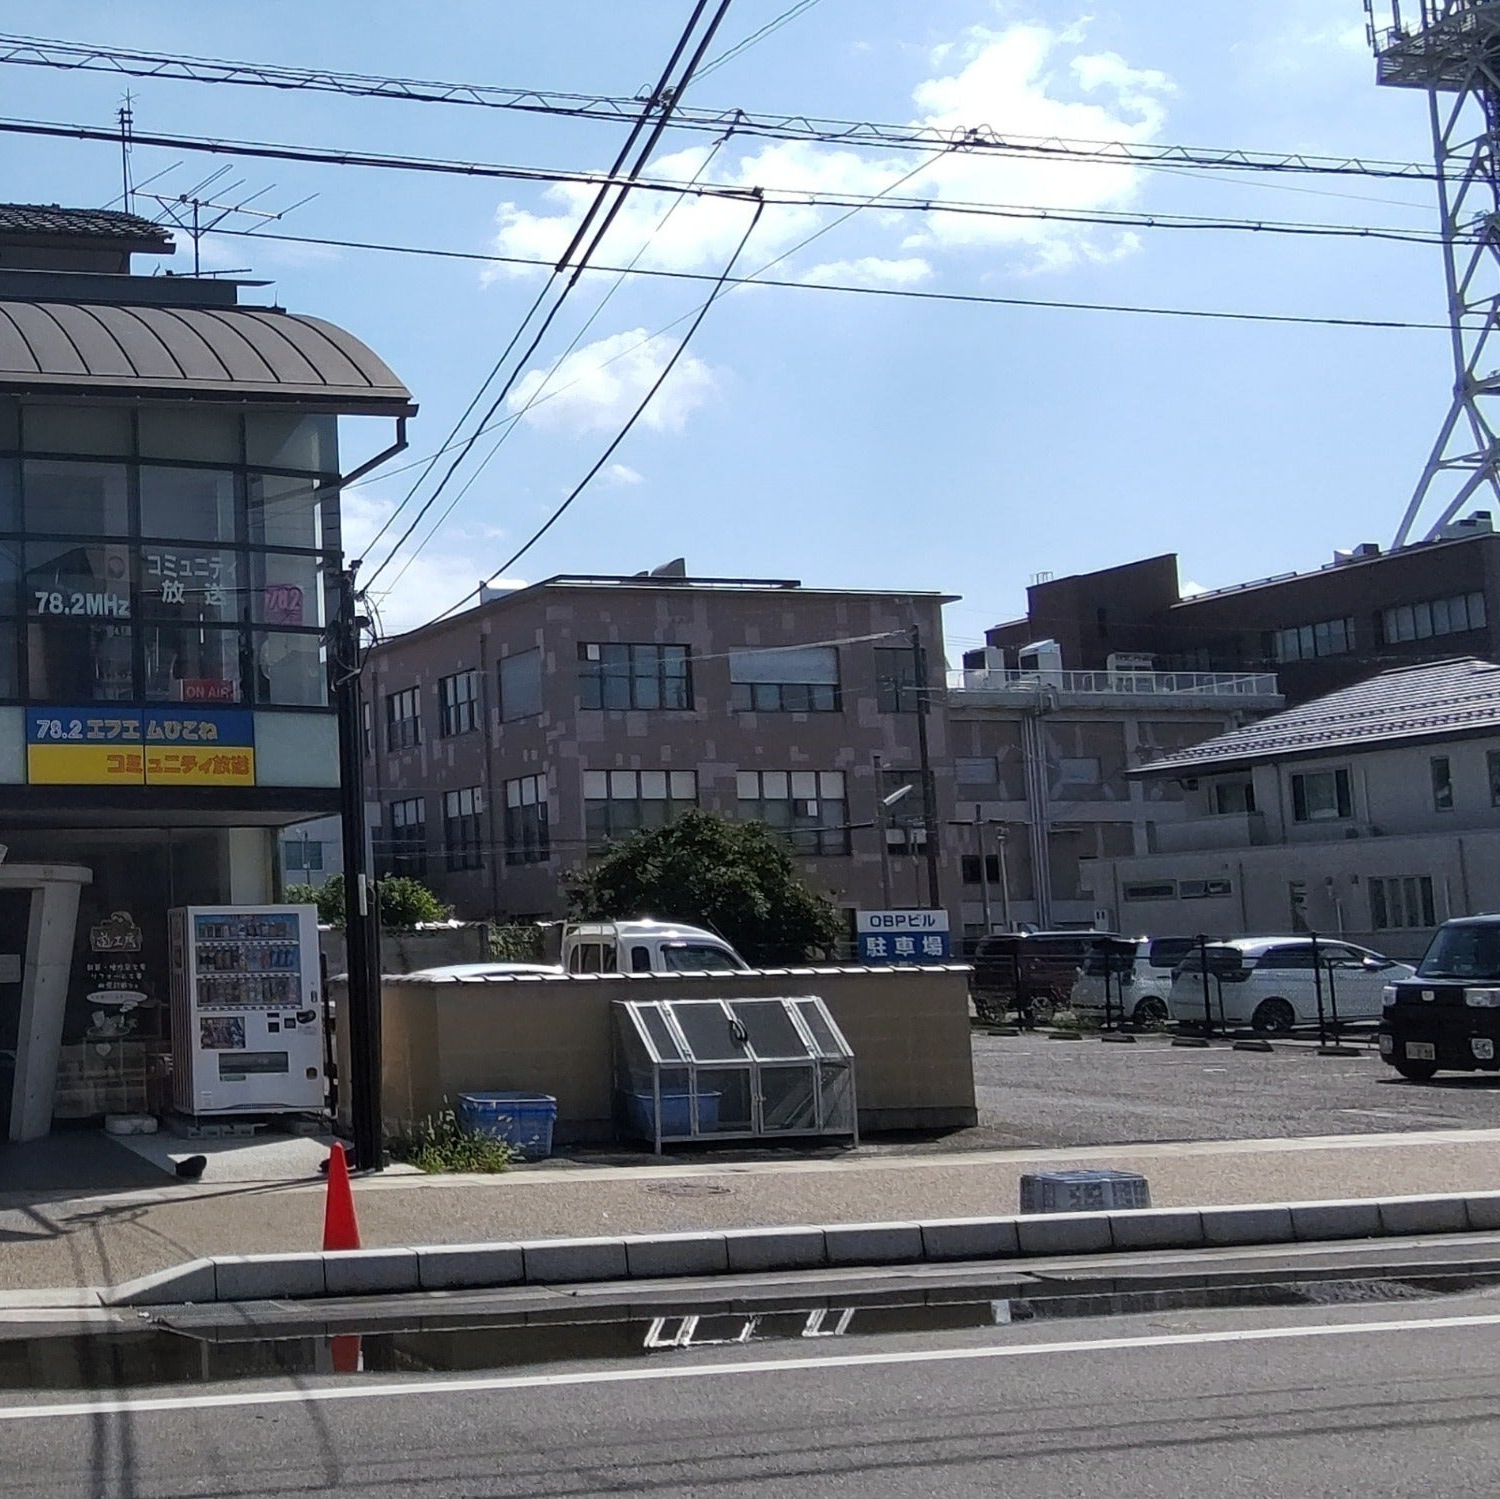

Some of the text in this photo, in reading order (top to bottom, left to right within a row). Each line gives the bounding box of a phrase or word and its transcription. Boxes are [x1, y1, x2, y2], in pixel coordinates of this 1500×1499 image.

[148, 555, 236, 579] コミュニティ
[35, 591, 131, 618] 78.2MHz
[186, 686, 229, 699] ON AIR
[37, 719, 83, 740] 78.2
[107, 754, 250, 775] コミュニティ放送
[870, 915, 936, 927] OBPビル
[866, 936, 943, 957] 駐車場
